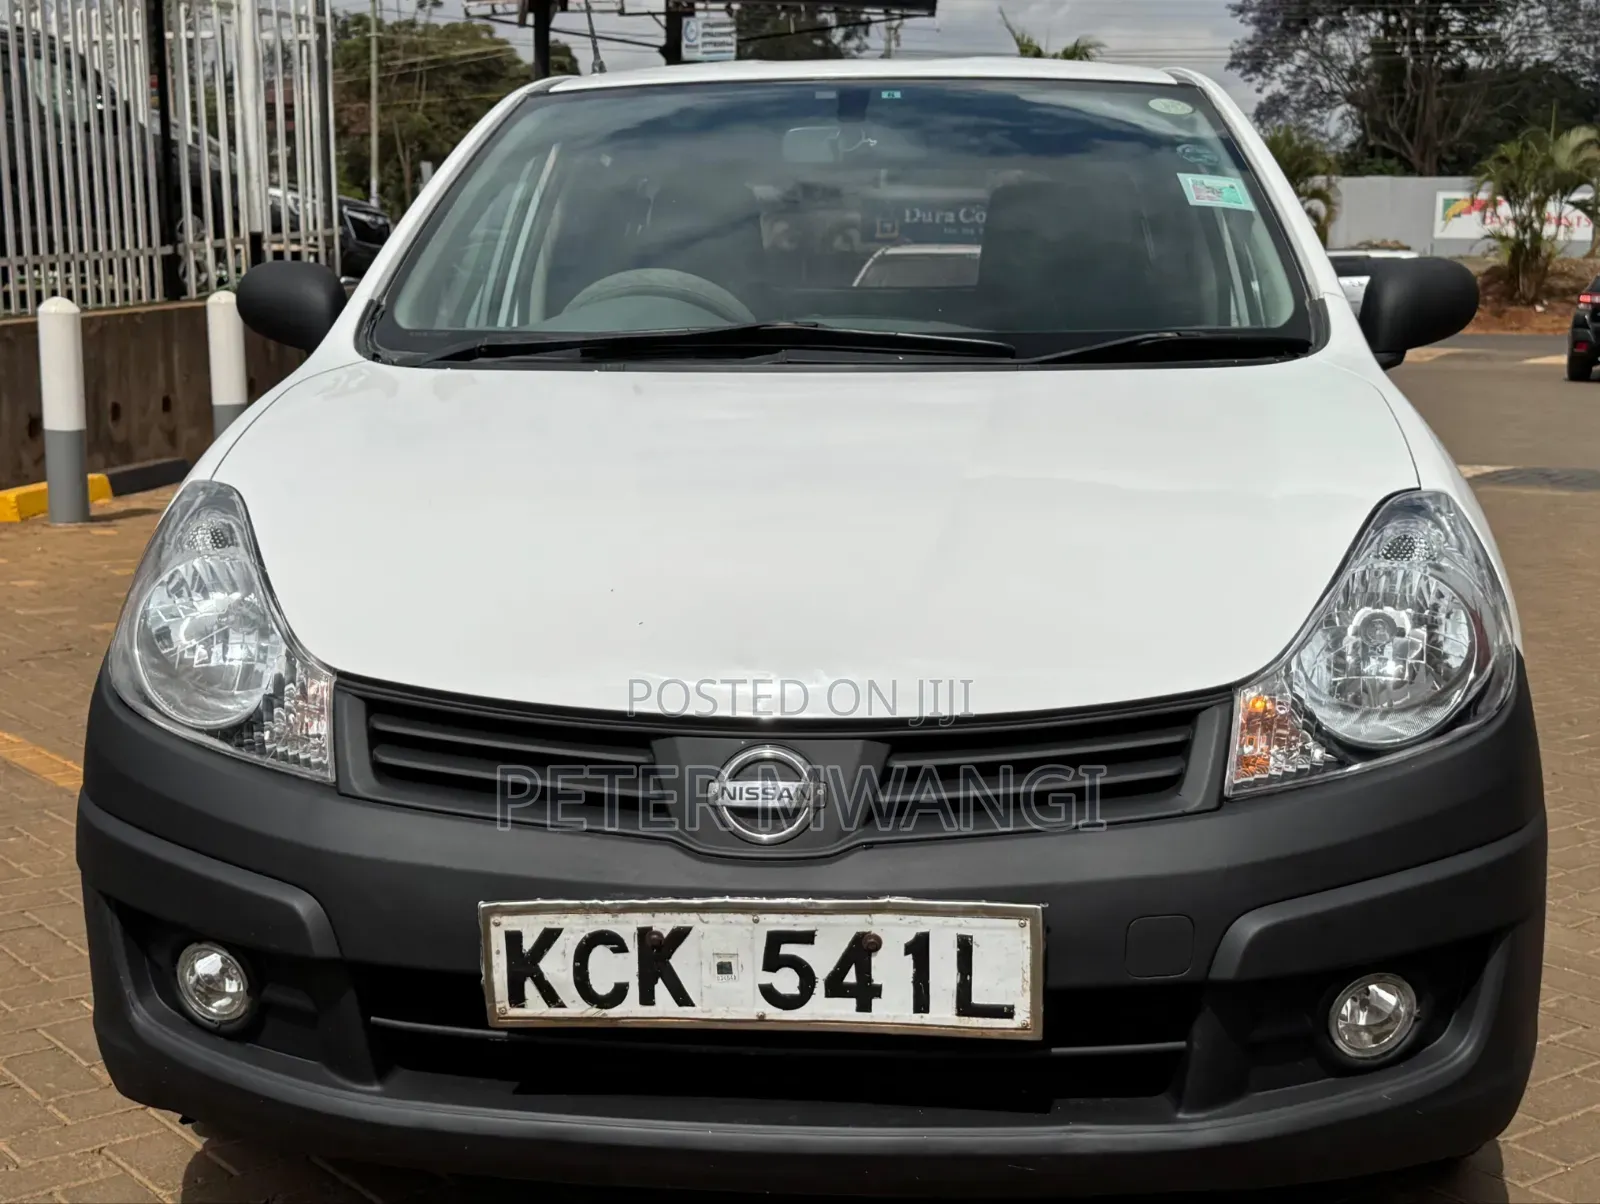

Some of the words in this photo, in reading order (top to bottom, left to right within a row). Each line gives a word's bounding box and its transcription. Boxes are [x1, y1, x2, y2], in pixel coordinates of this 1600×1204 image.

[904, 207, 956, 224] Dura
[721, 786, 811, 801] NISSAN
[504, 926, 696, 1010] KCK
[758, 929, 1015, 1020] 541L
